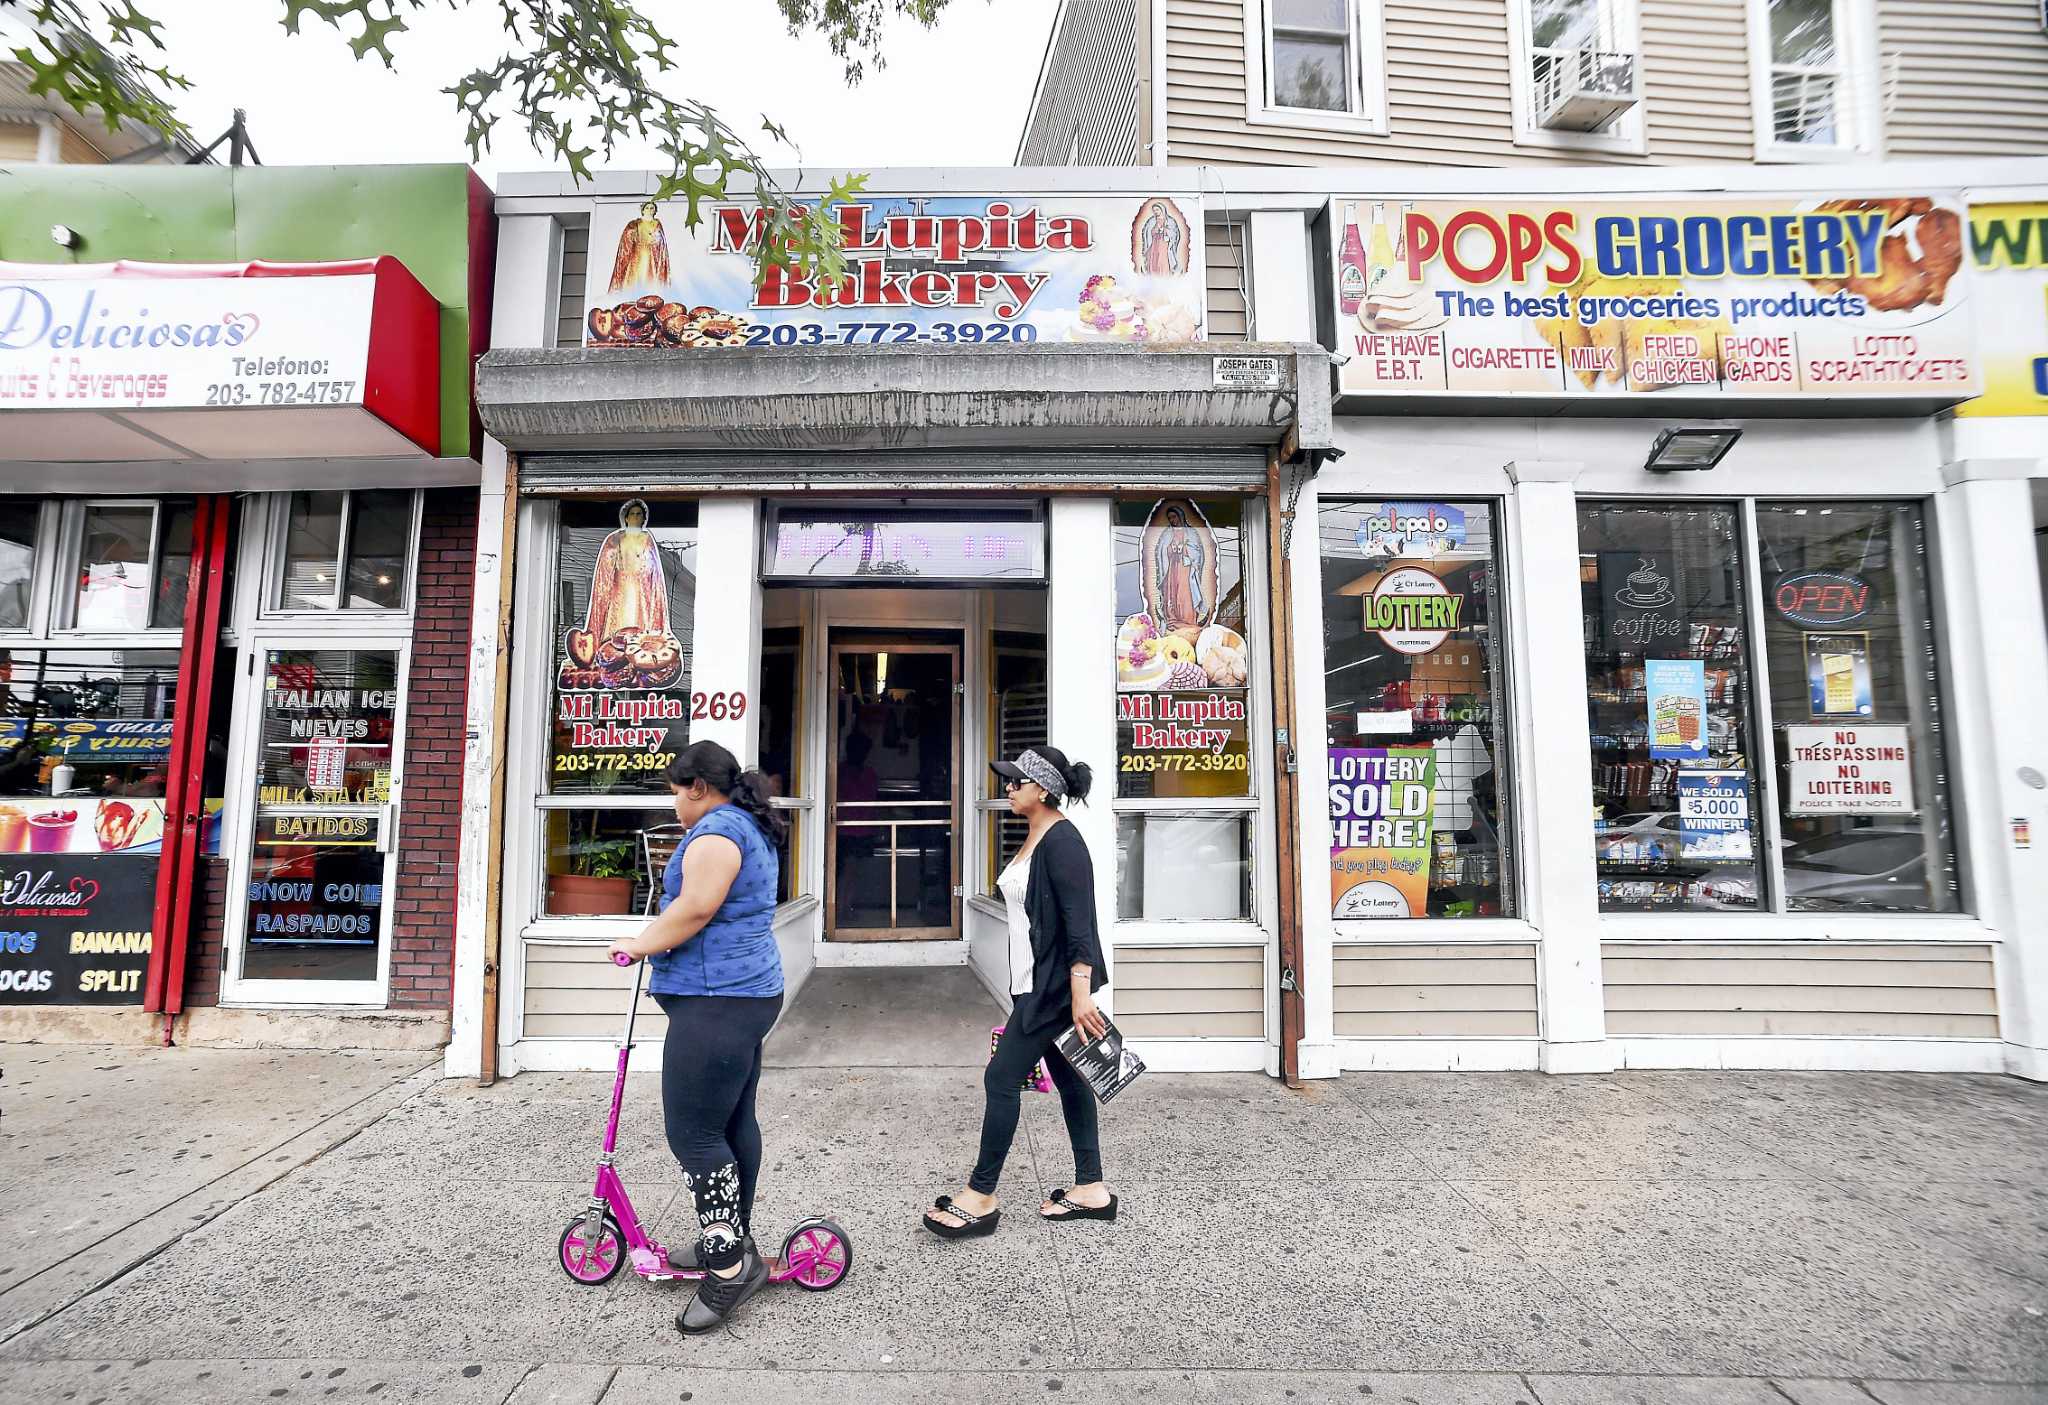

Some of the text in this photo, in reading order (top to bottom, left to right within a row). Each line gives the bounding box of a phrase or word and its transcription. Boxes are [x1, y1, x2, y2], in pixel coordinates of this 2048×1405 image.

[833, 202, 1093, 263] Lupita
[1406, 211, 1885, 284] POPS GROCERY
[750, 258, 1049, 318] Bakery
[1435, 291, 1865, 324] The best groceries products
[746, 322, 1037, 345] 203-772-3920
[1355, 336, 1440, 357] WE HAVE
[1645, 336, 1698, 357] FRIED
[1725, 337, 1789, 358] PHONE
[1854, 336, 1917, 356] LOTTO
[232, 357, 329, 377] Telefono:
[1218, 359, 1273, 369] JOSEPH GATES
[1452, 348, 1556, 369] CIGARETTE
[1571, 348, 1615, 370] MILK
[1376, 359, 1423, 380] E.B.T.
[1632, 360, 1716, 383] CHICKEN
[1727, 360, 1792, 382] CARDS
[66, 357, 168, 406] Beverages
[1776, 585, 1869, 613] OPEN
[1365, 595, 1461, 629] LOTTERY
[1612, 611, 1681, 644] coffee
[266, 690, 397, 709] ITALIAN ICE
[559, 693, 682, 724] Mi Lupita
[691, 691, 747, 721] 269
[1118, 693, 1245, 725] Mi Lupita
[290, 719, 368, 738] NIEVES
[572, 723, 668, 752] Bakery
[1133, 724, 1231, 753] Bakery
[1836, 731, 1857, 745] NO
[1121, 754, 1247, 772] 203-772-3920
[1795, 747, 1905, 761] TRESPASSING
[1329, 757, 1430, 781] LOTTERY
[1838, 765, 1860, 778] NO
[260, 786, 306, 804] MILK
[1682, 788, 1745, 798] WE SOLD A
[1808, 782, 1893, 795] LOITERING
[1329, 784, 1429, 817] SOLD
[275, 817, 368, 836] BATIDOS
[1330, 820, 1427, 848] HERE!
[1684, 818, 1745, 831] WINNER!
[247, 882, 382, 902] SNOW CONE
[1373, 898, 1400, 908] Lottery
[255, 913, 371, 934] RASPADOS
[69, 931, 152, 954] BANANA
[79, 970, 142, 992] SPLIT
[700, 1208, 731, 1225] OVER
